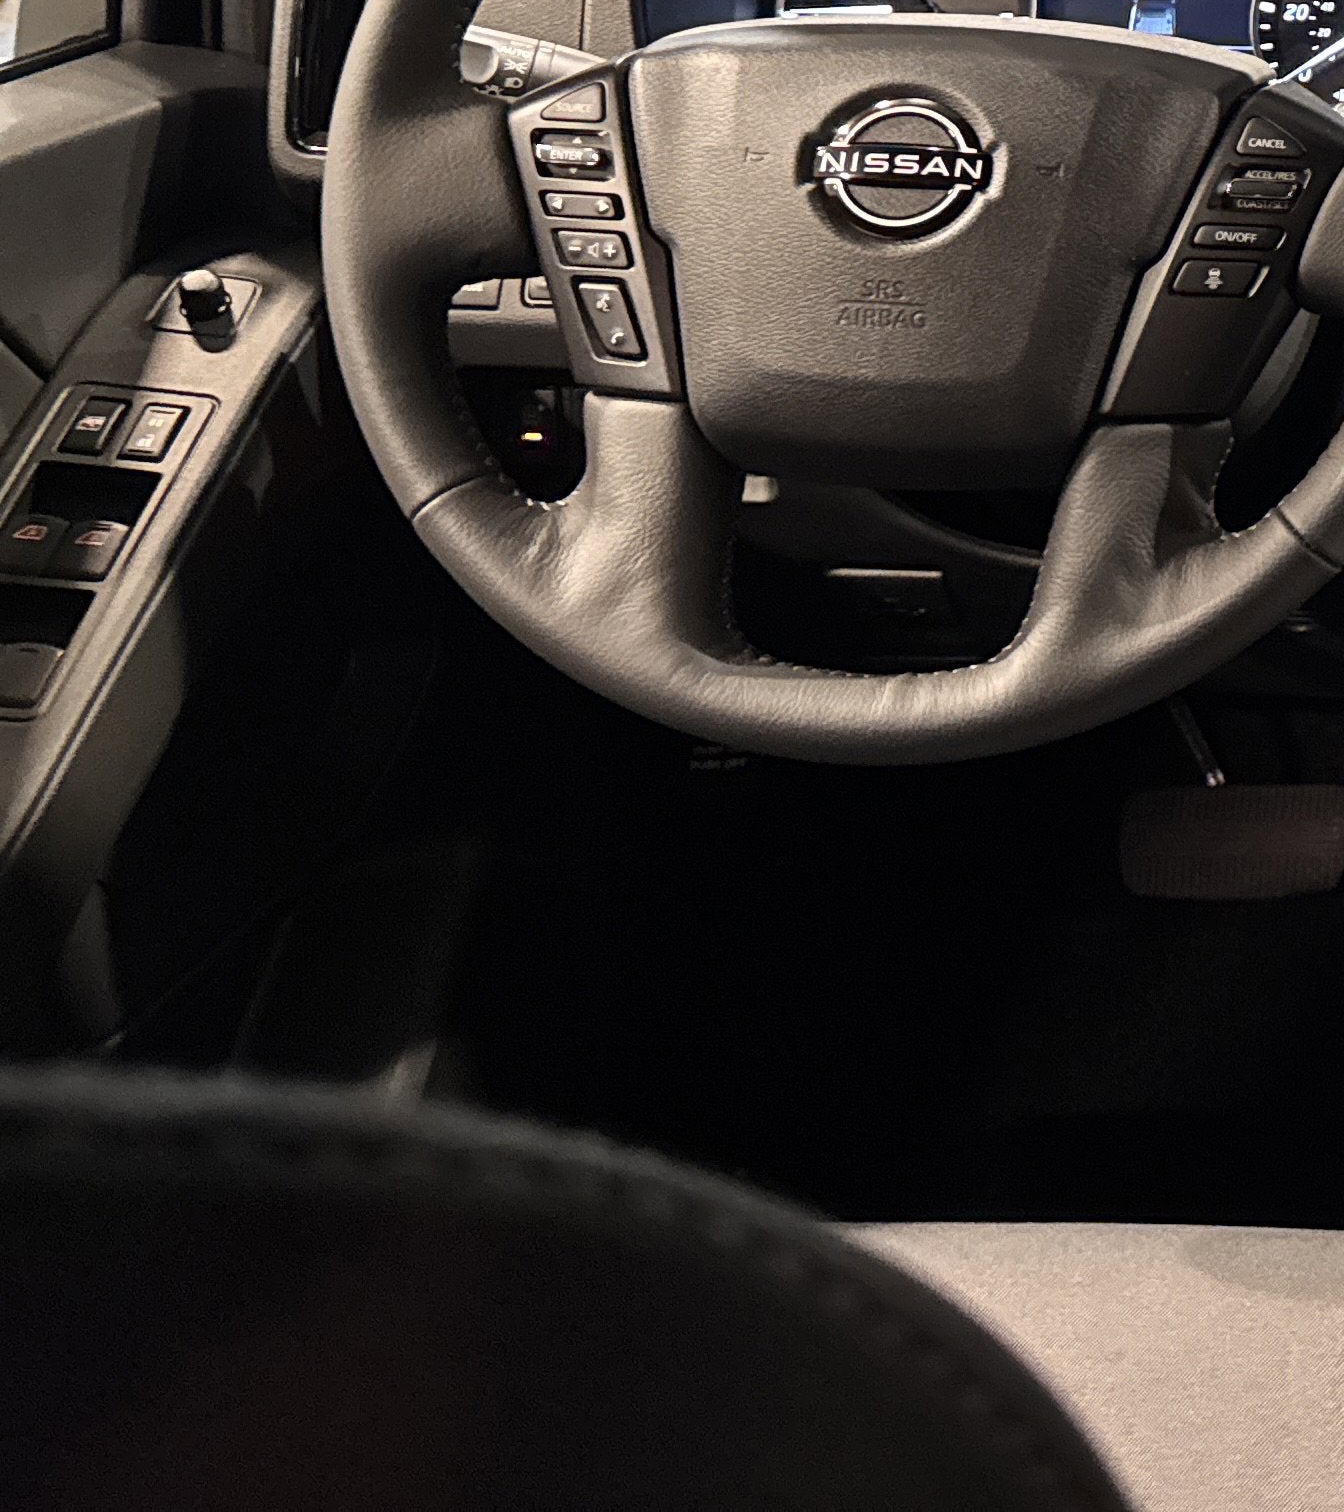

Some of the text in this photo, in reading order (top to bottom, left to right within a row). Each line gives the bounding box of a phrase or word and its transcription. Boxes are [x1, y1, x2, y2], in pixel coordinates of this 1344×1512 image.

[1282, 3, 1310, 22] 20
[1248, 137, 1287, 150] CANCEL
[549, 149, 583, 161] ENTER
[818, 149, 983, 180] NISSAN
[1215, 231, 1258, 243] ON/OFF
[861, 279, 905, 299] SRS
[836, 306, 926, 329] AIRBAG
